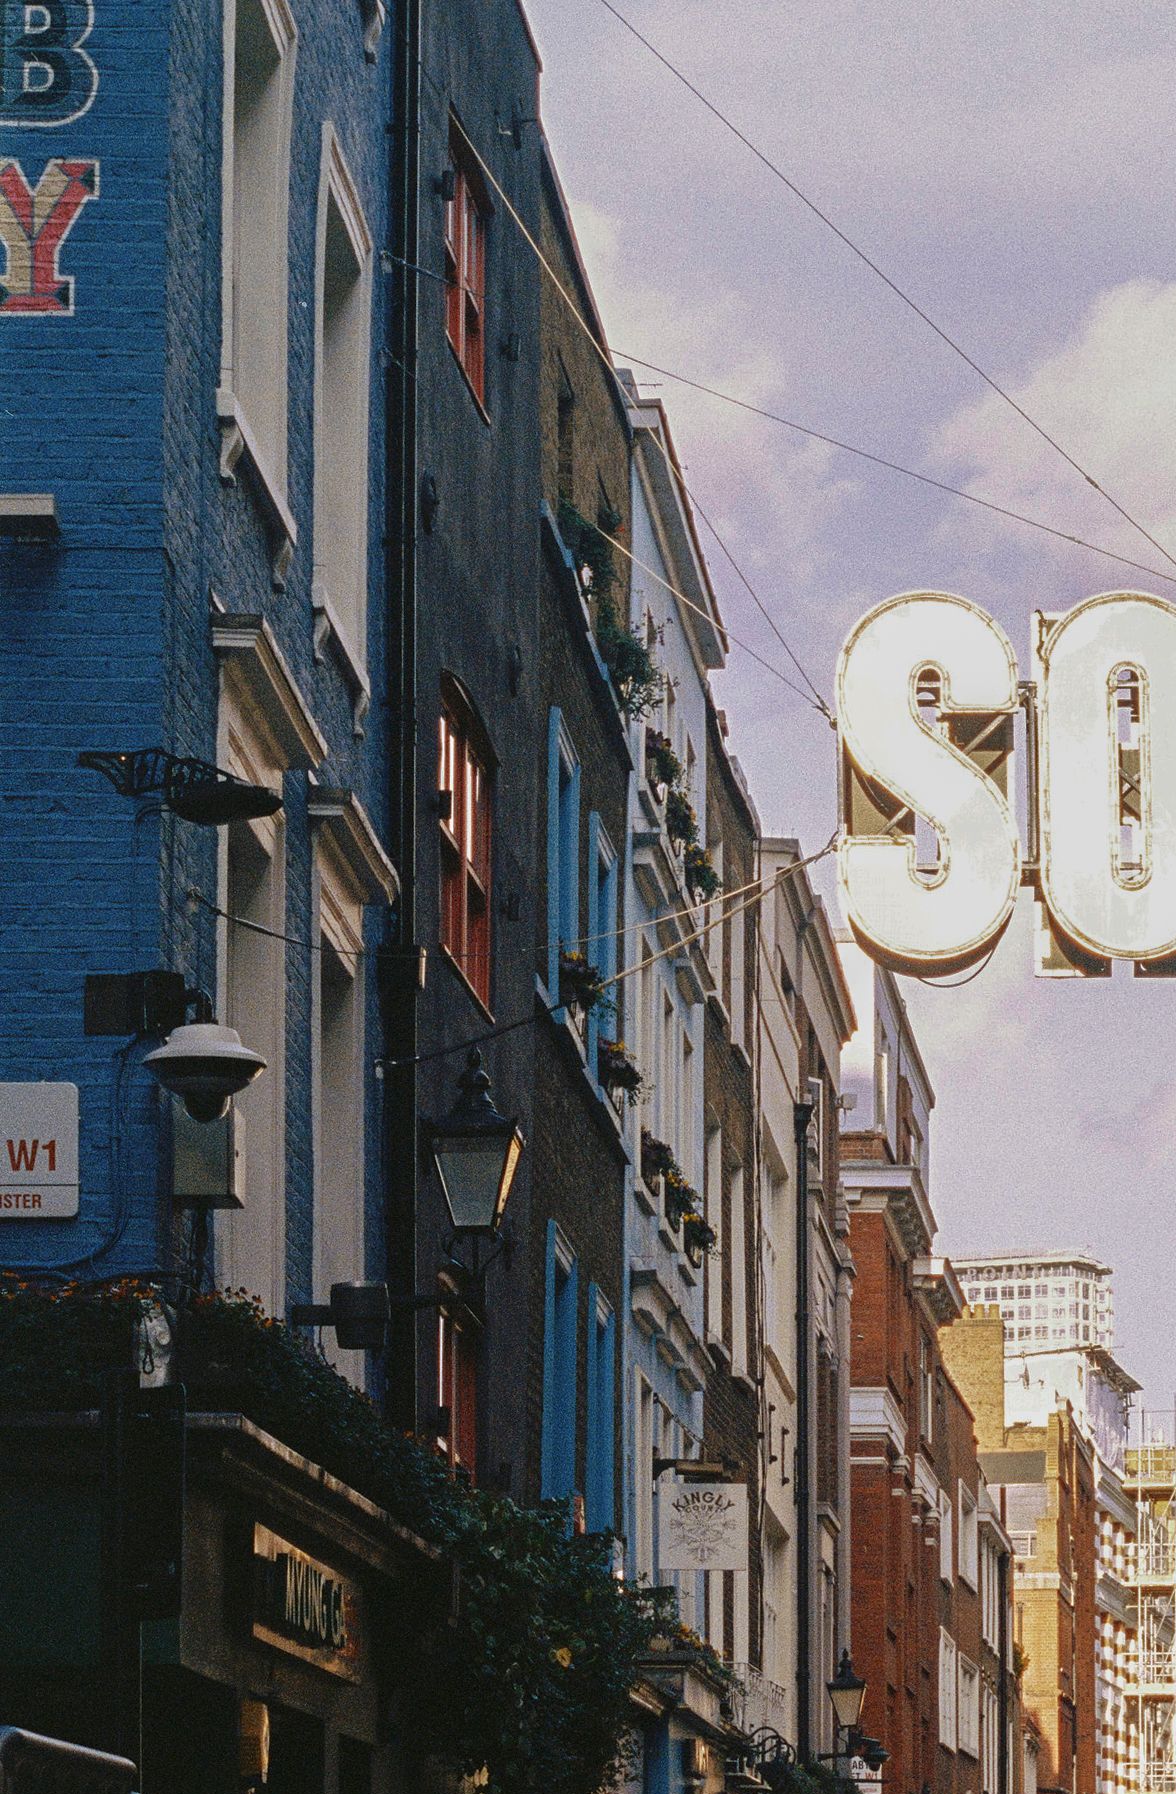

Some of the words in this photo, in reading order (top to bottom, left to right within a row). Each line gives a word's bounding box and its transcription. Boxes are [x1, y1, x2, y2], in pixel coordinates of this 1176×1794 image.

[6, 1138, 57, 1172] W1
[0, 1193, 42, 1209] STER
[967, 1264, 1041, 1282] POINT
[672, 1491, 735, 1513] KINGLY
[285, 1552, 327, 1640] MYUNG
